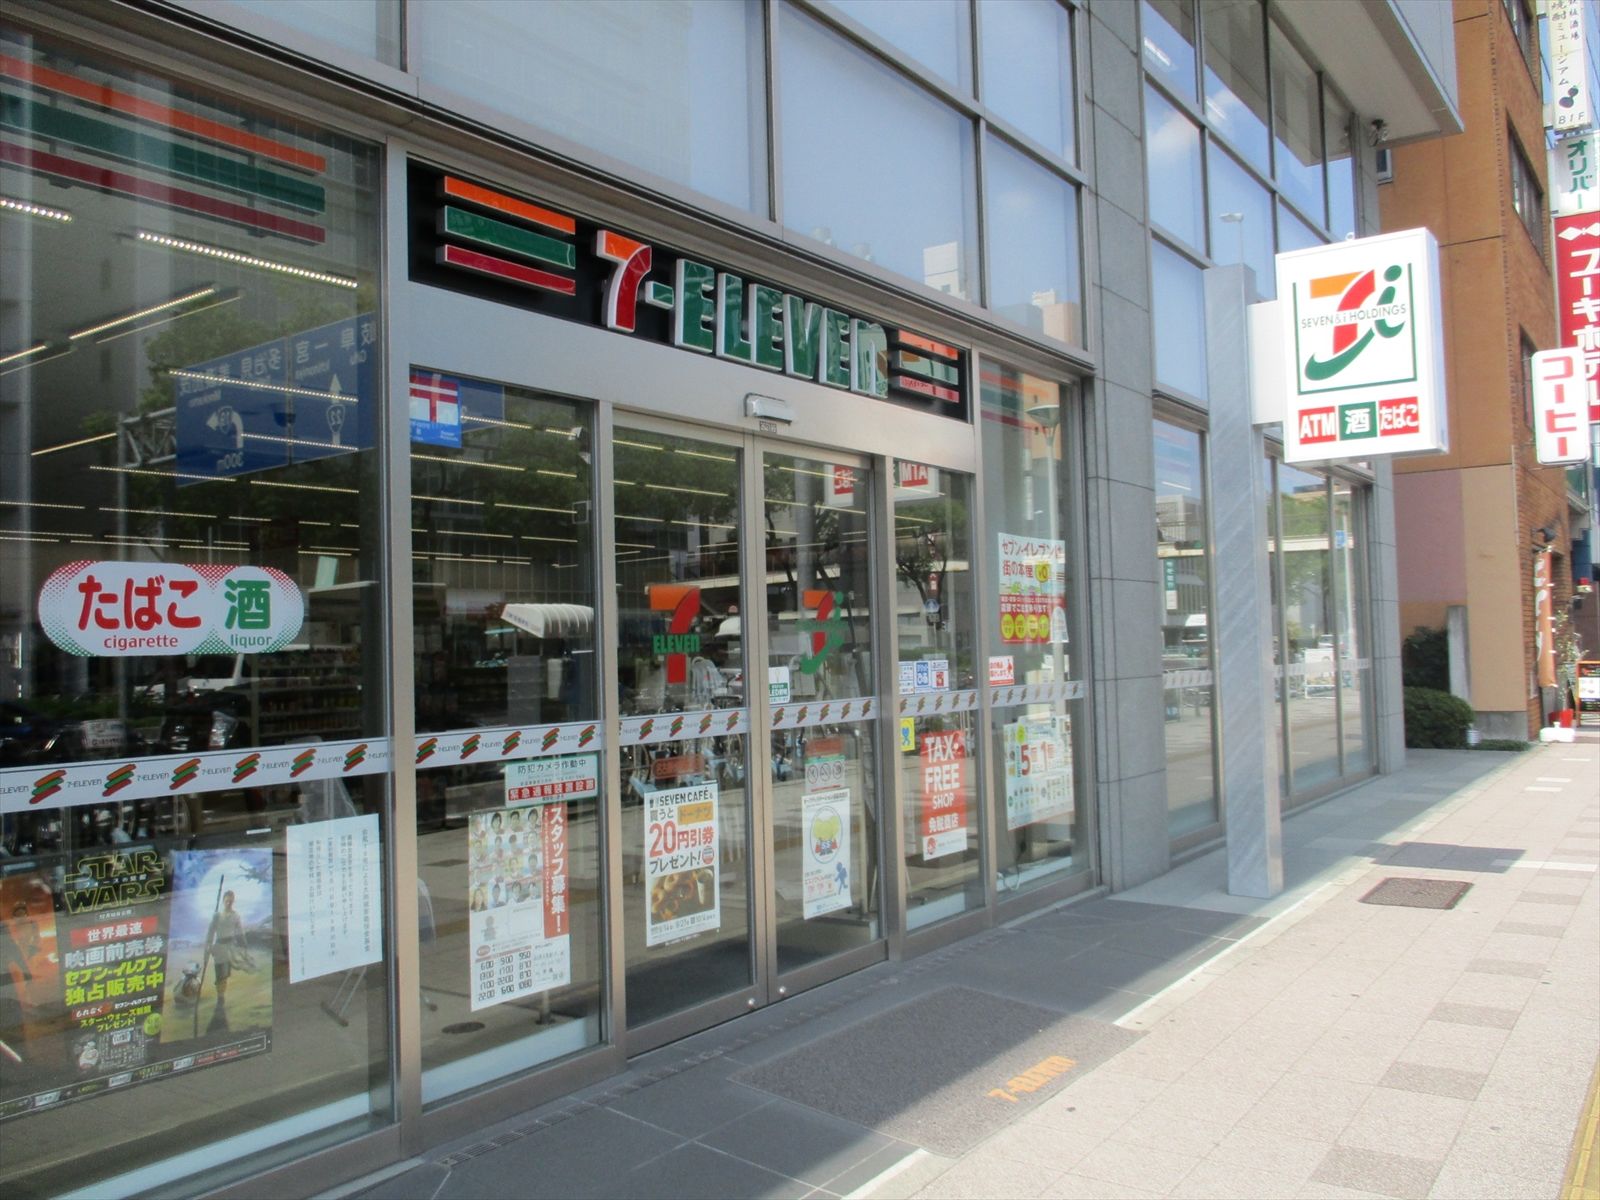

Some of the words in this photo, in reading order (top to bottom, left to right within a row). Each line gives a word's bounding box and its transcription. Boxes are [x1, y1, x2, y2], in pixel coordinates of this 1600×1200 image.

[1567, 139, 1593, 209] オリバー
[1349, 303, 1407, 322] HOLDINGS
[1379, 403, 1420, 431] たばこ
[1542, 355, 1577, 457] コーヒー
[1300, 412, 1336, 438] ATM
[1345, 408, 1370, 435] 酒
[78, 574, 202, 631] たばこ
[224, 579, 272, 630] 酒
[103, 634, 179, 652] cigarette
[229, 633, 273, 650] liquor
[925, 735, 955, 763] TAX
[518, 759, 587, 774] 防犯カメラ作動中
[925, 763, 960, 794] FREE
[660, 792, 687, 807] SEVEN
[932, 792, 955, 810] SHOP
[650, 807, 675, 822] 買うと
[649, 820, 714, 858] 20円引券
[64, 850, 165, 885] STAR
[650, 850, 702, 875] プレゼント!
[64, 879, 164, 914] WARS
[88, 922, 143, 942] 世界最速
[65, 936, 164, 968] 映画前売券
[65, 956, 163, 986] セブン-イレブン
[65, 972, 164, 1006] 独占販売中
[76, 1006, 103, 1018] もれなく
